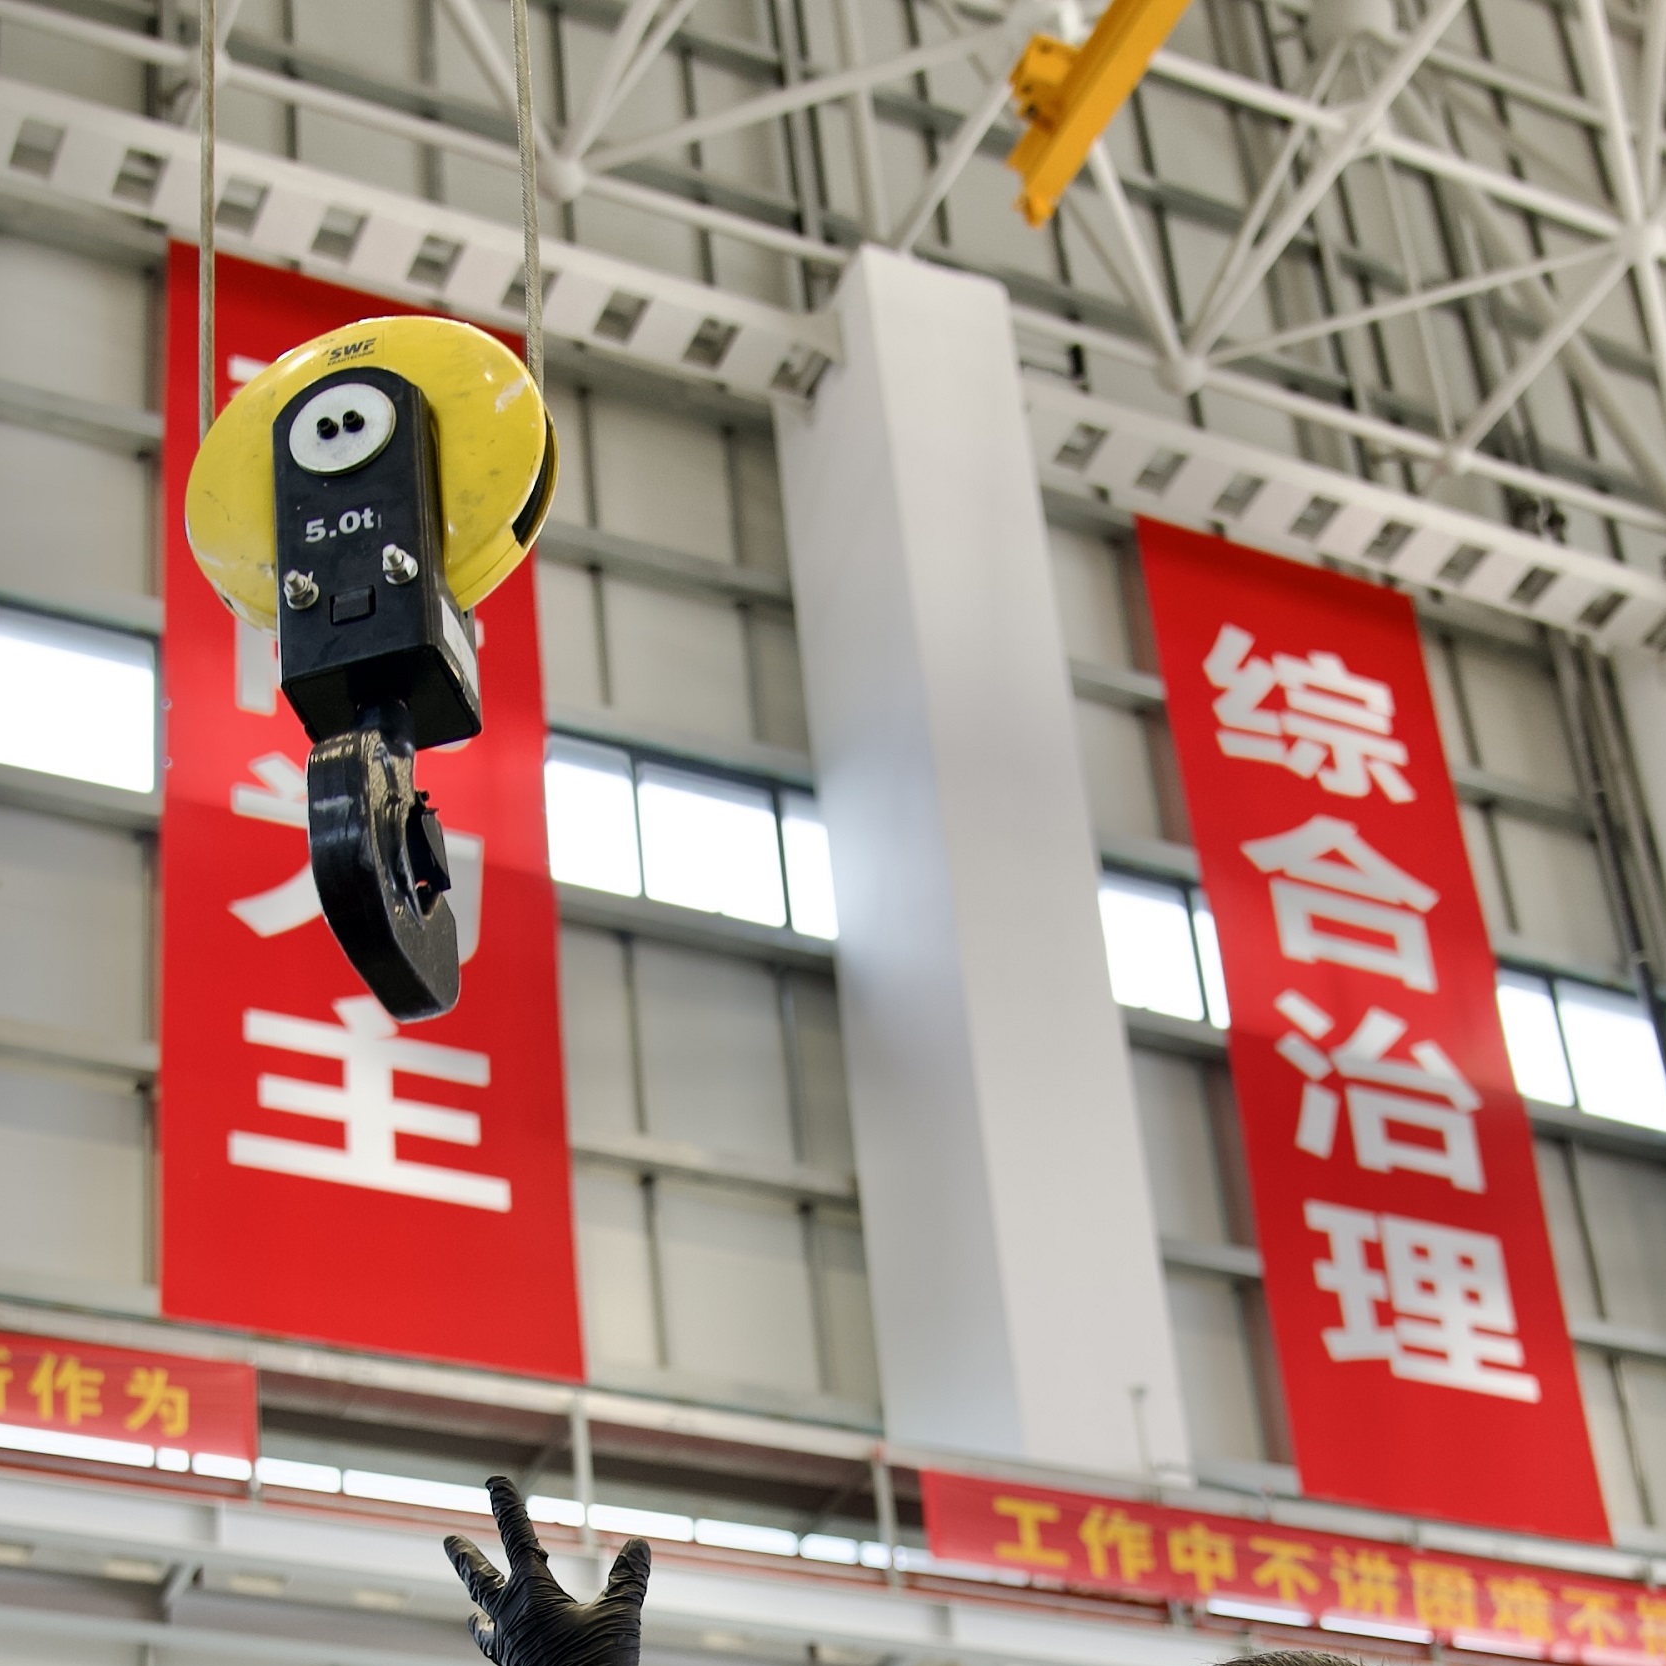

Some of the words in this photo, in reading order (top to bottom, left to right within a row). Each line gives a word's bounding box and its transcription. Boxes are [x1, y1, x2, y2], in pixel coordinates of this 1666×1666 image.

[329, 337, 377, 361] SWF
[304, 507, 374, 544] 5.0t
[1202, 623, 1541, 1404] 综合治理
